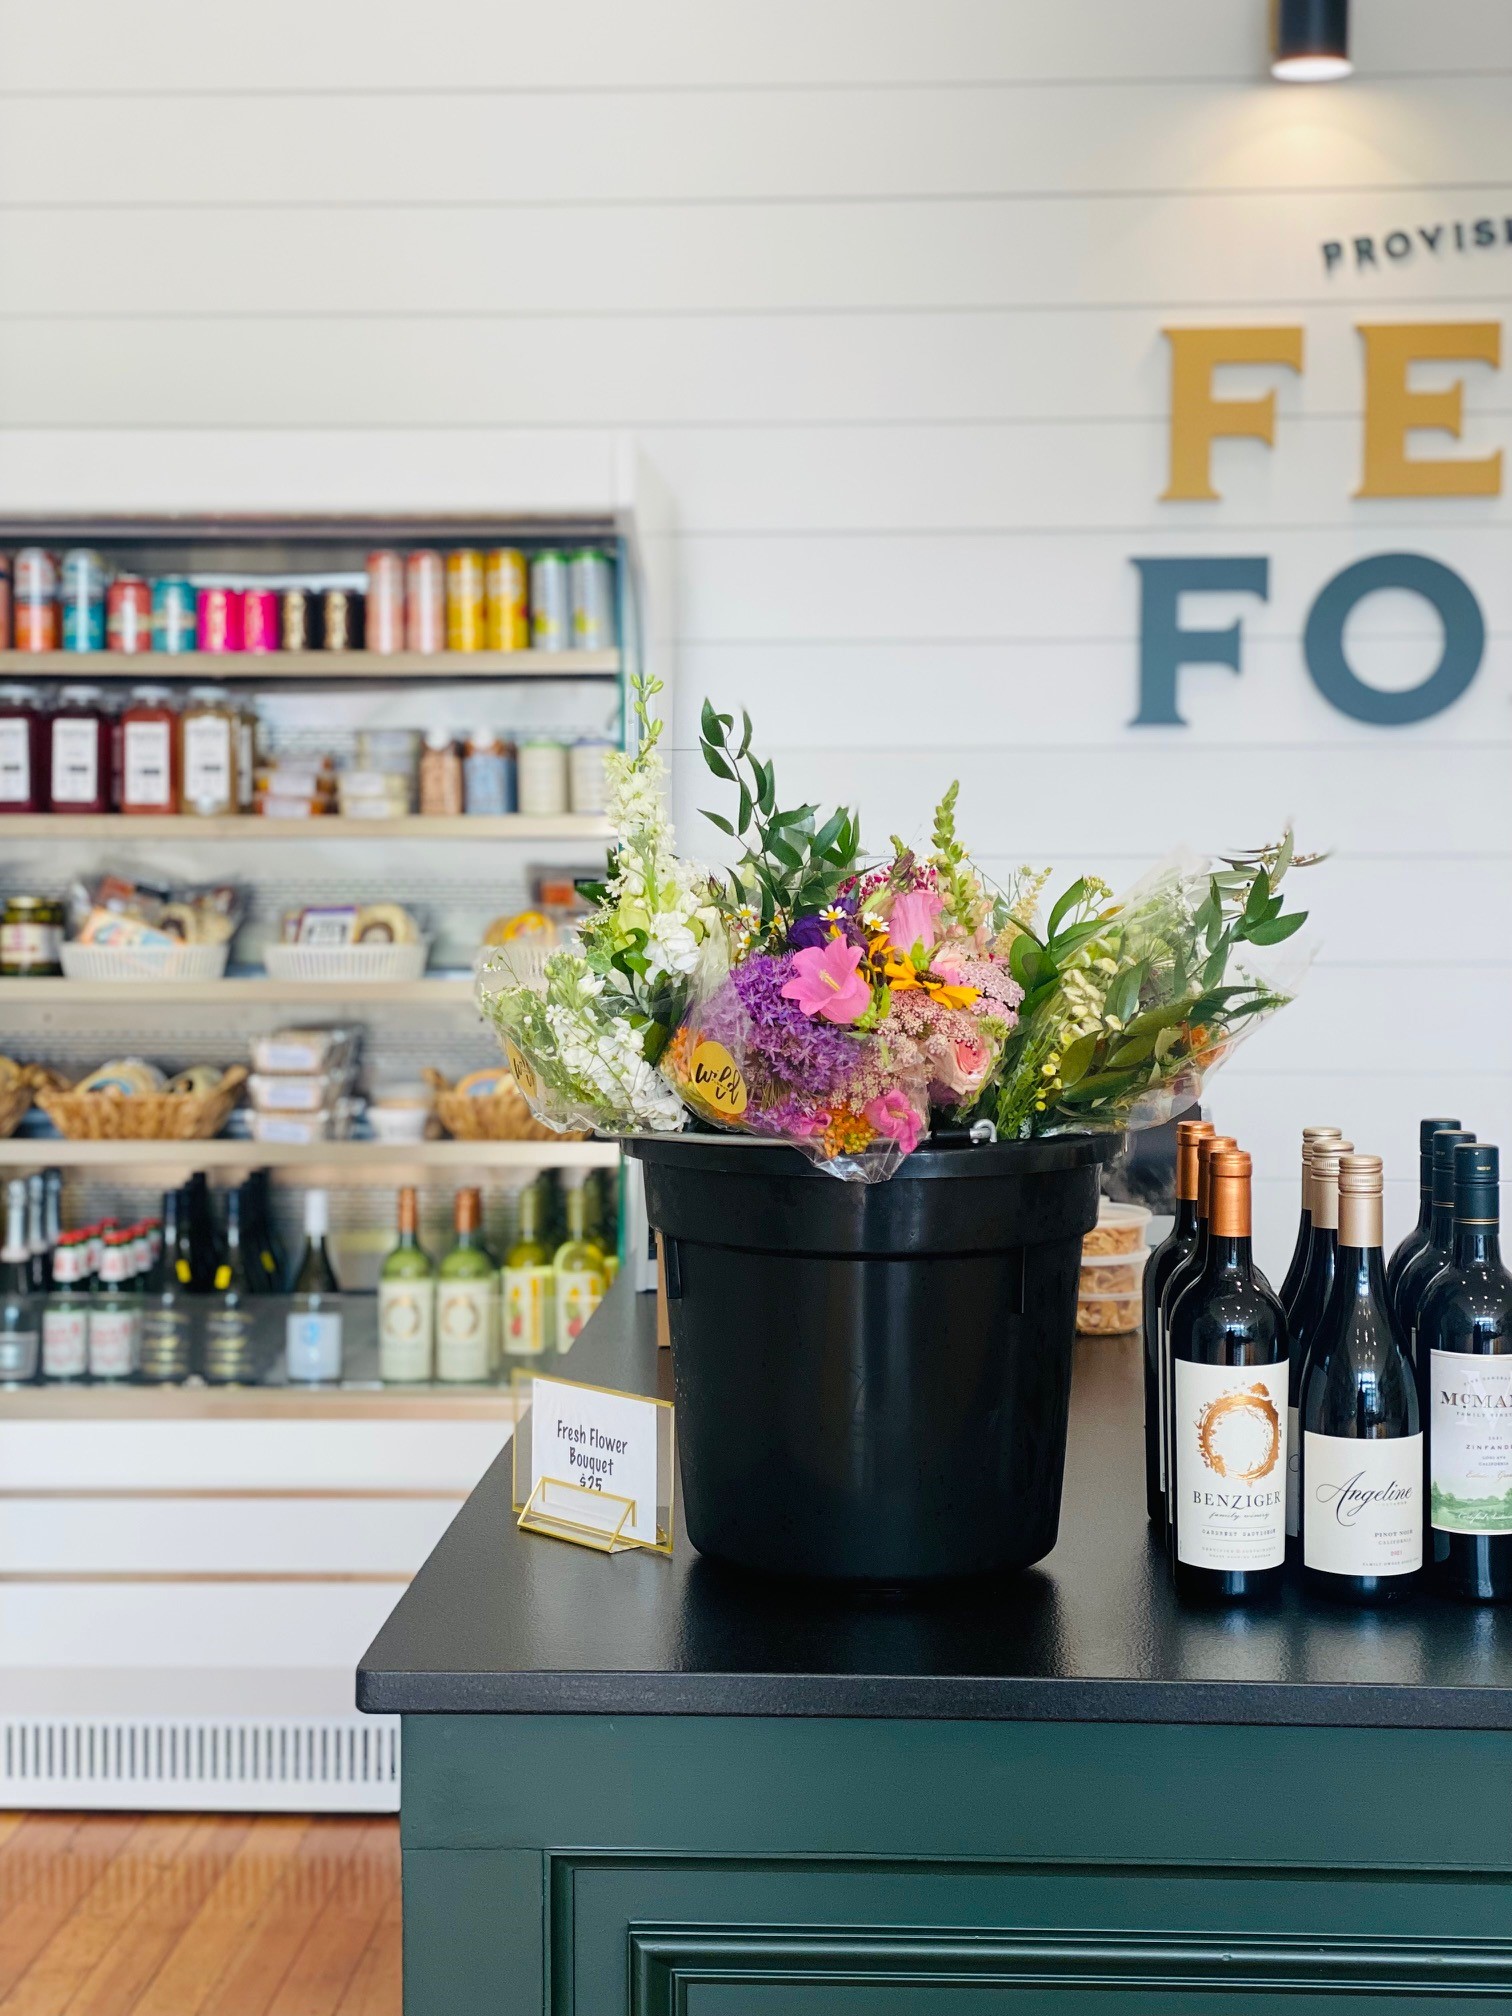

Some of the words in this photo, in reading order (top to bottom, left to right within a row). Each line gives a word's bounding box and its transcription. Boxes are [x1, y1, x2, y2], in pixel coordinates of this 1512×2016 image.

[1157, 320, 1504, 503] FE
[1126, 550, 1486, 728] FO
[557, 1420, 586, 1444] Fresh
[589, 1428, 628, 1455] Flower
[569, 1447, 614, 1476] Bouquet
[579, 1473, 603, 1492] $25
[1193, 1490, 1281, 1510] BENZIGER
[1316, 1470, 1413, 1527] Angeline
